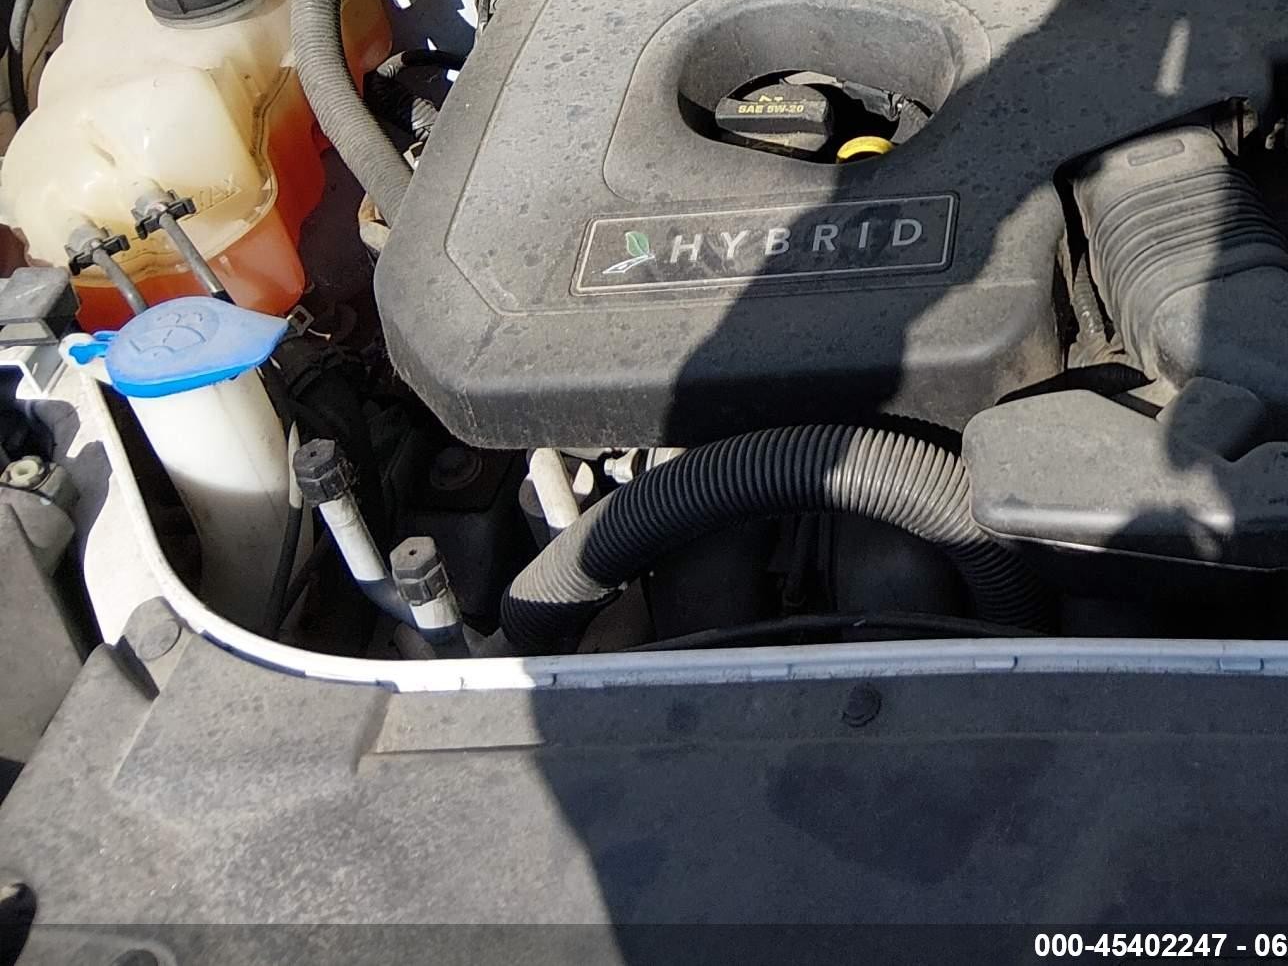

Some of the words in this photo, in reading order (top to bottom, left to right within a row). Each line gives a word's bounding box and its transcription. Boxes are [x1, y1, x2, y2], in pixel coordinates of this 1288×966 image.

[738, 105, 763, 113] SAE
[767, 105, 804, 113] 5W-20
[669, 218, 924, 264] HYBRID
